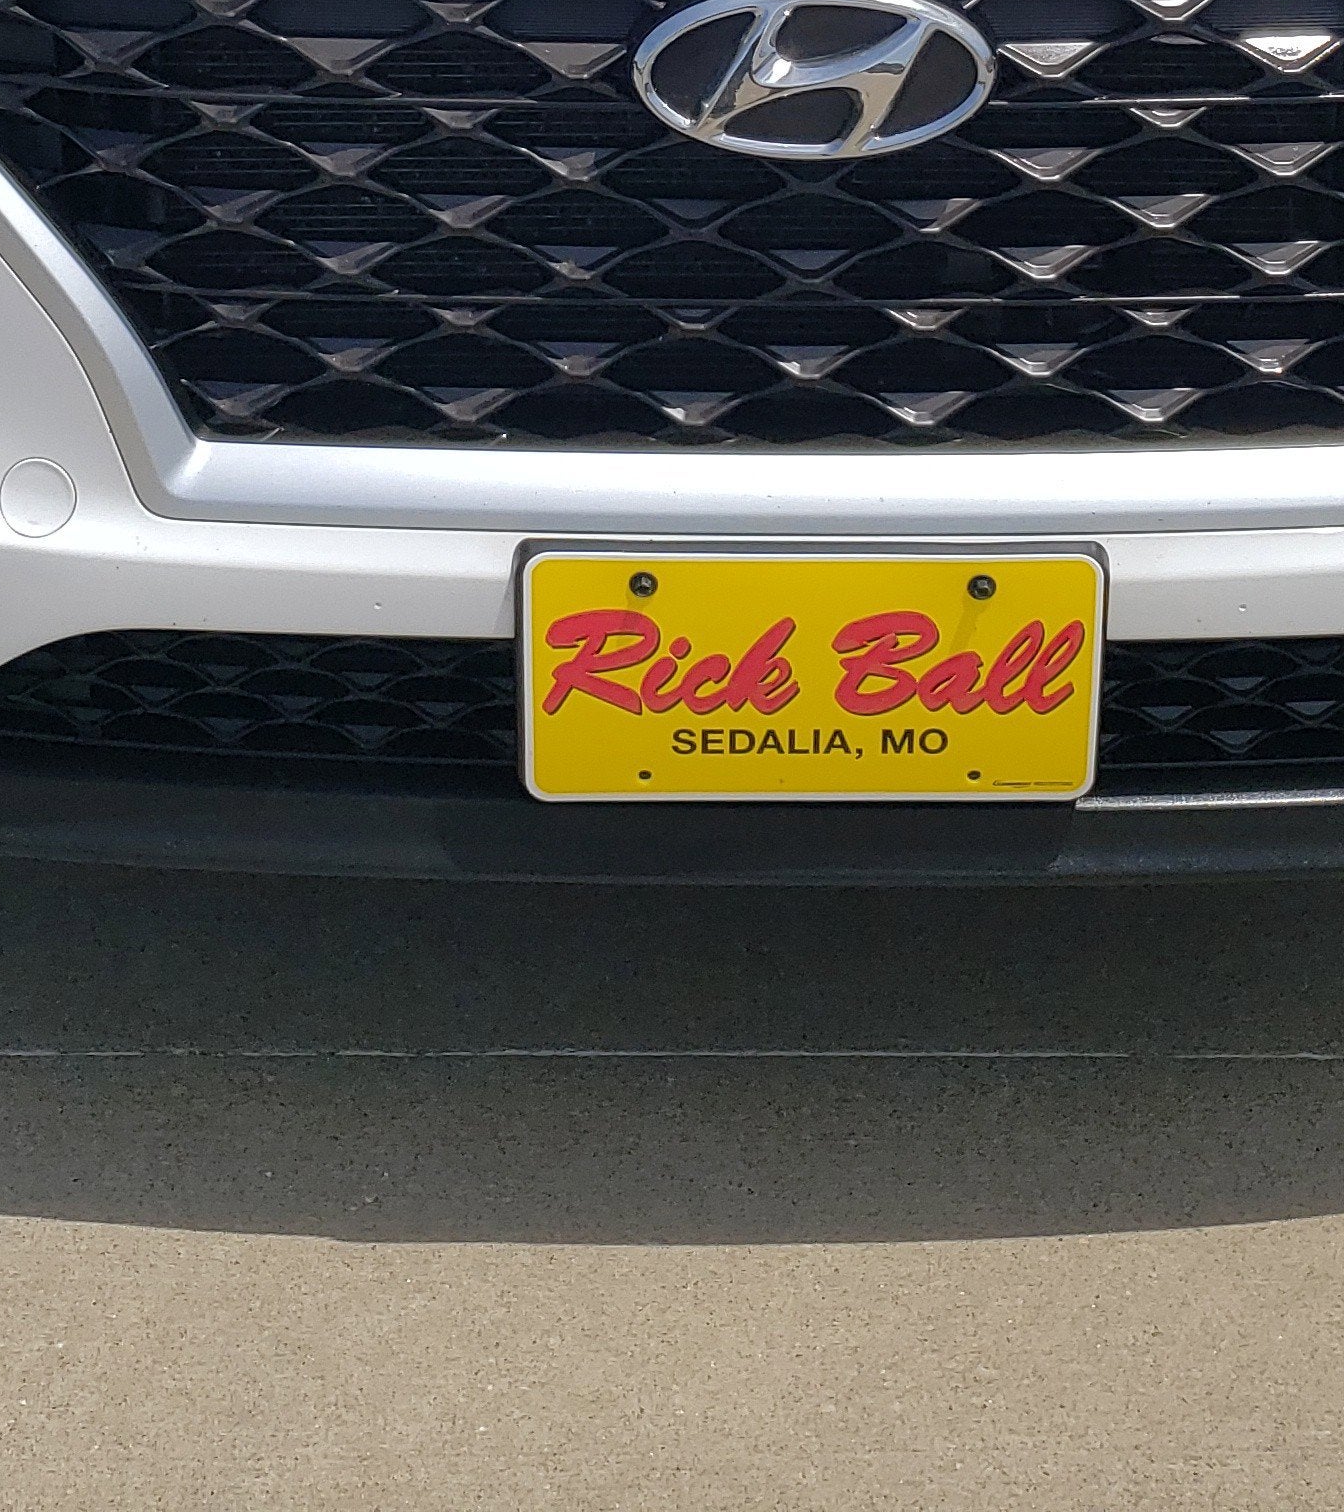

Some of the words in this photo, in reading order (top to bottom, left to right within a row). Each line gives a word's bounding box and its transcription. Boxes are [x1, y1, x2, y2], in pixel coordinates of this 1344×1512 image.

[542, 609, 800, 716] Rick
[831, 611, 1085, 716] Ball
[671, 728, 863, 759] SEDALIA,
[881, 728, 949, 756] MO
